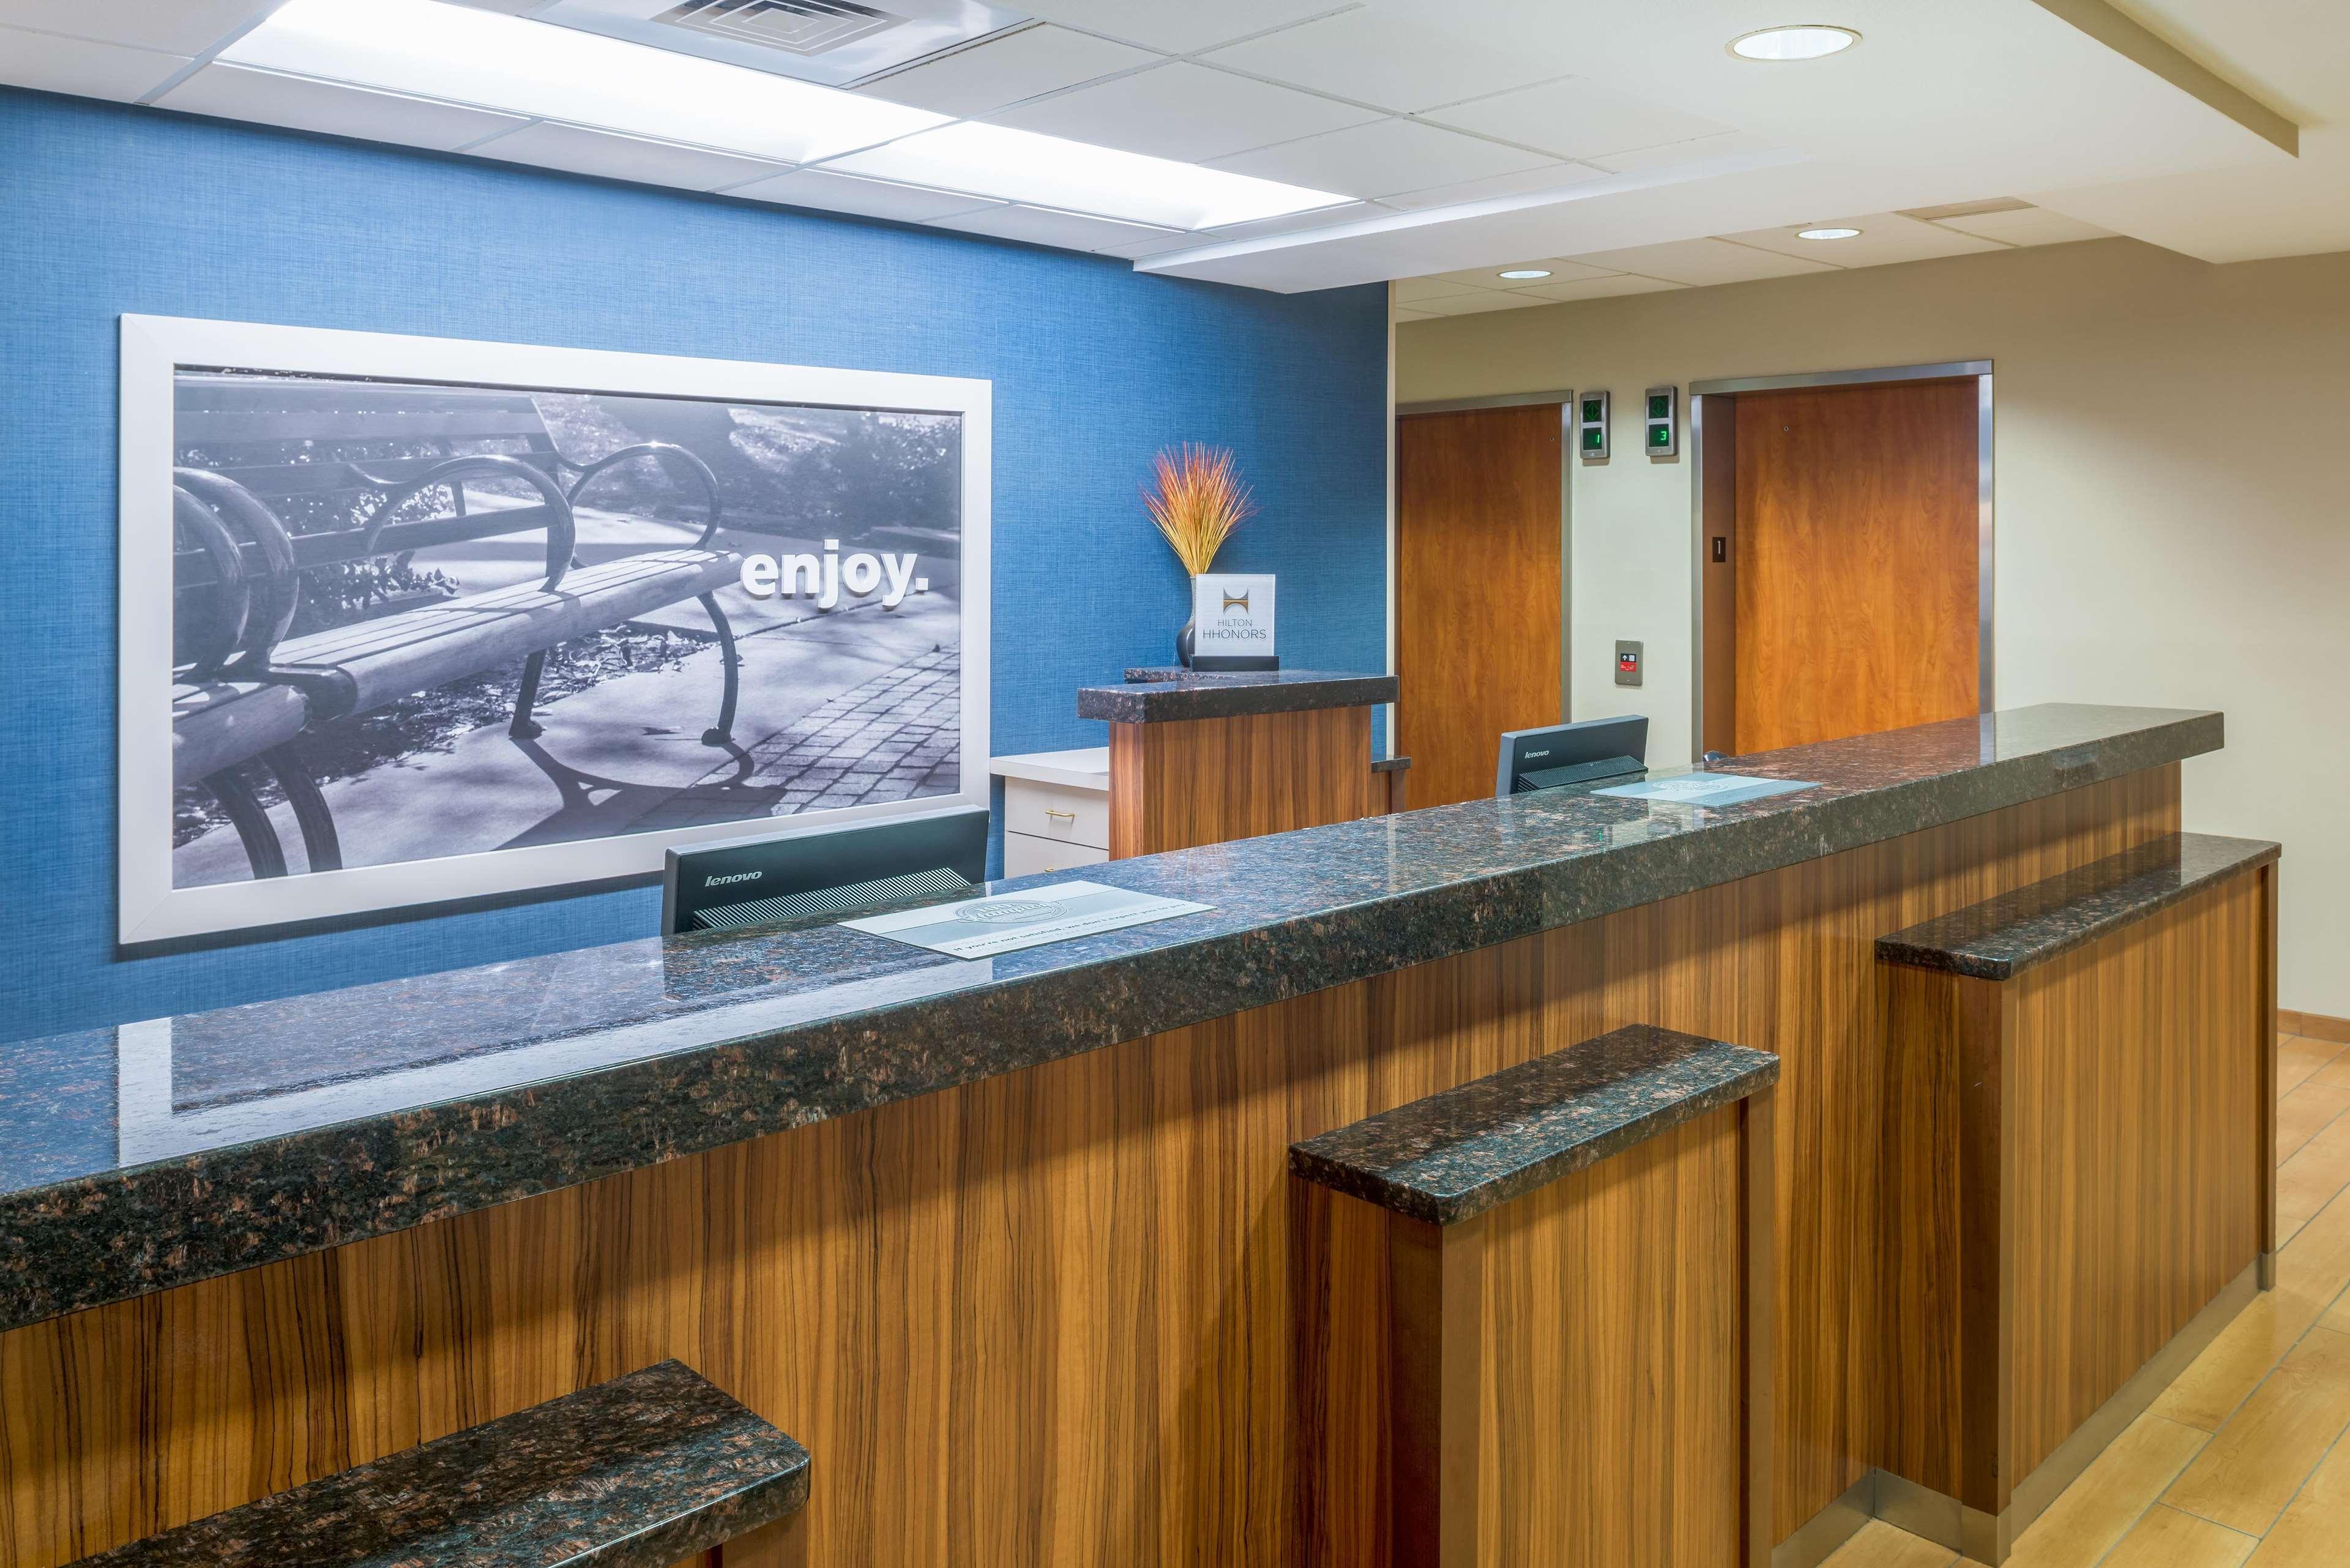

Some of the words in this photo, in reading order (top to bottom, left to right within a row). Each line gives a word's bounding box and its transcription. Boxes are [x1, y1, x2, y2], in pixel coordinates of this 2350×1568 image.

[1660, 431, 1667, 440] 3
[1717, 541, 1721, 554] 1
[740, 539, 928, 608] enjoy.
[1203, 629, 1267, 639] HHONORS
[1524, 750, 1550, 759] lenovo
[705, 871, 763, 887] lenovo
